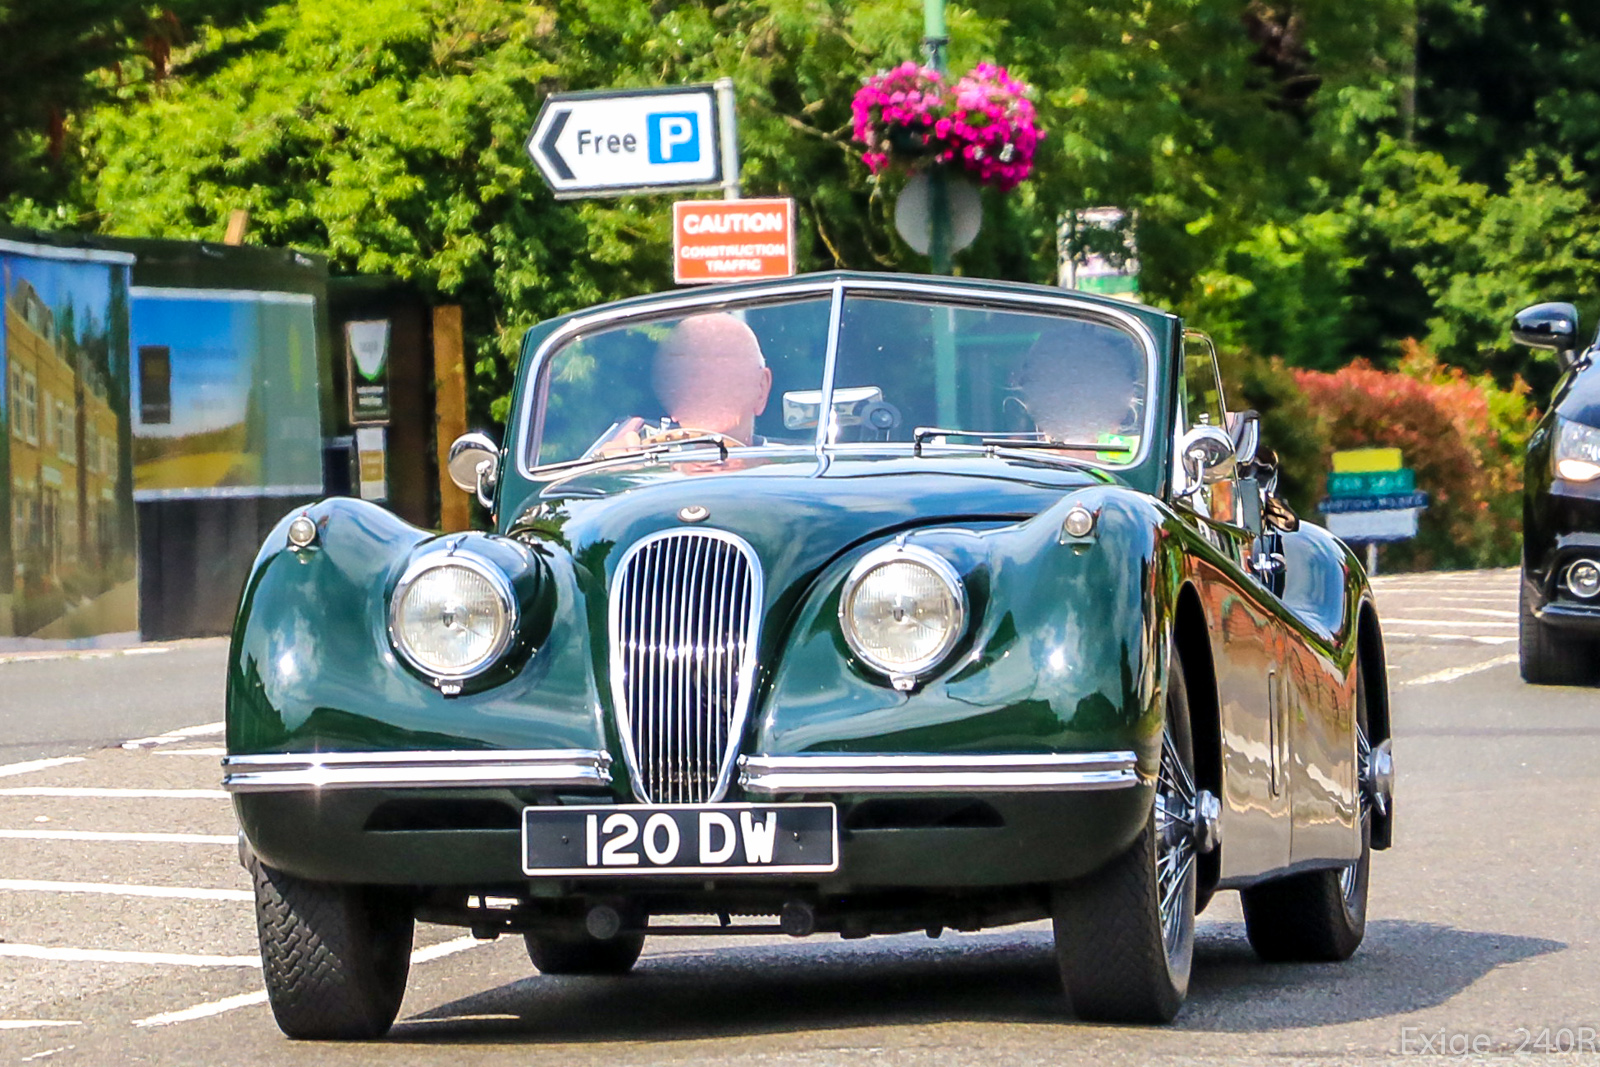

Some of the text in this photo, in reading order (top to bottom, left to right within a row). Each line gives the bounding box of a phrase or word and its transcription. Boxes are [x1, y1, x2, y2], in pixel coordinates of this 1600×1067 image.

[577, 116, 693, 160] Free P
[683, 212, 783, 234] CAUTION
[681, 244, 786, 258] CONSTRUCTION
[705, 258, 762, 273] TRAFFIC
[586, 811, 777, 866] 120 DW
